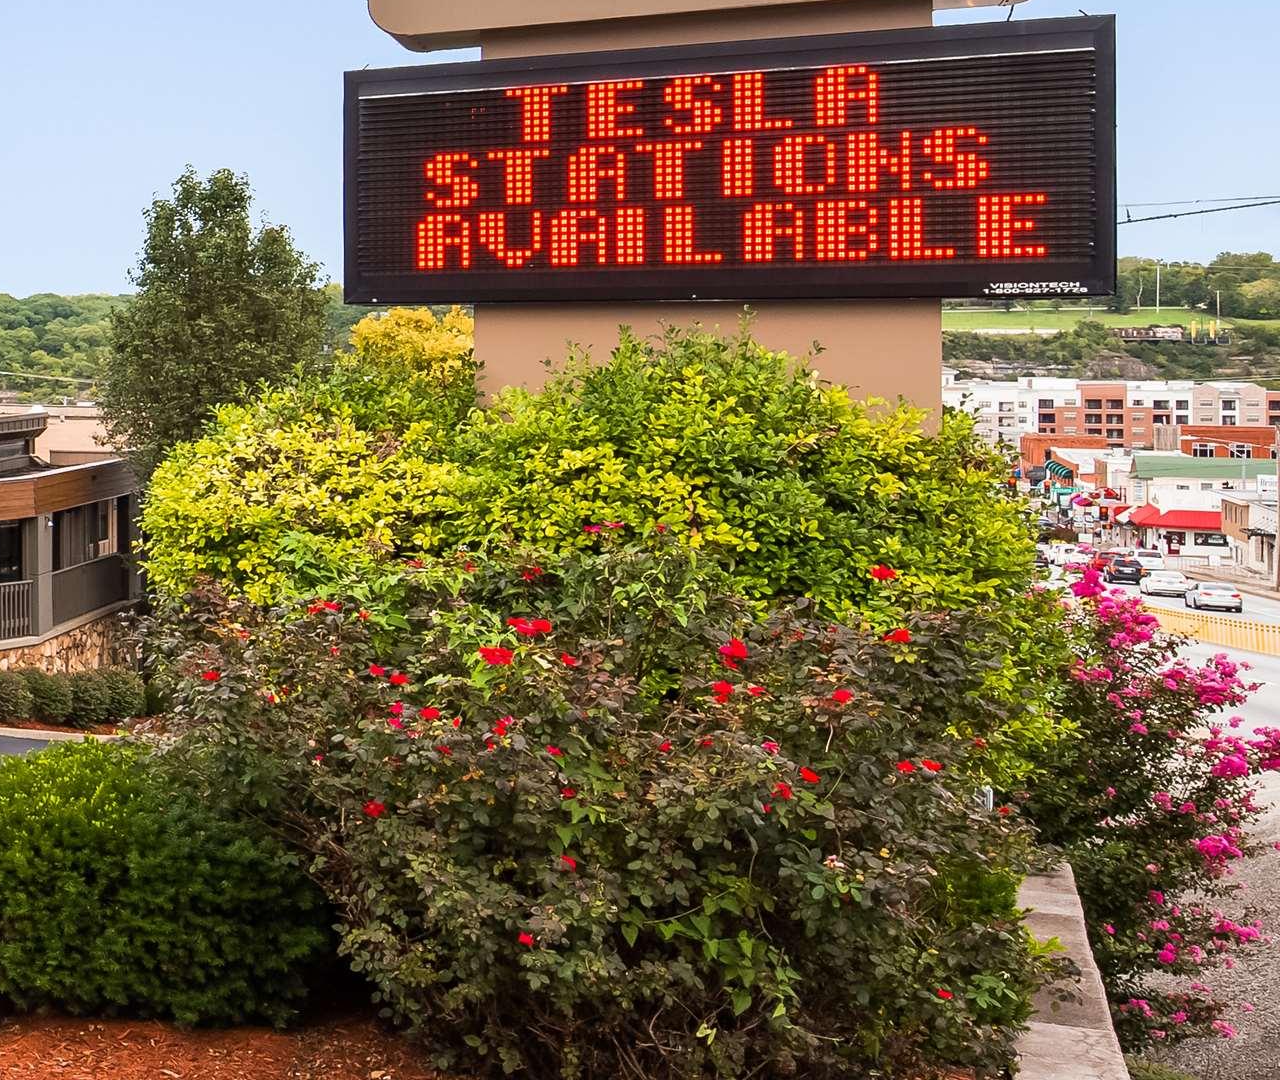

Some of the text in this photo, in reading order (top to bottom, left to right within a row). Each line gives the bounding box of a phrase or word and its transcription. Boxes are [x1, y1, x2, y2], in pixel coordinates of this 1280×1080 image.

[506, 64, 880, 143] TESLA
[424, 126, 990, 209] STATIONS
[415, 193, 1047, 270] AVAILABLE
[990, 281, 1080, 289] VISIONTECH
